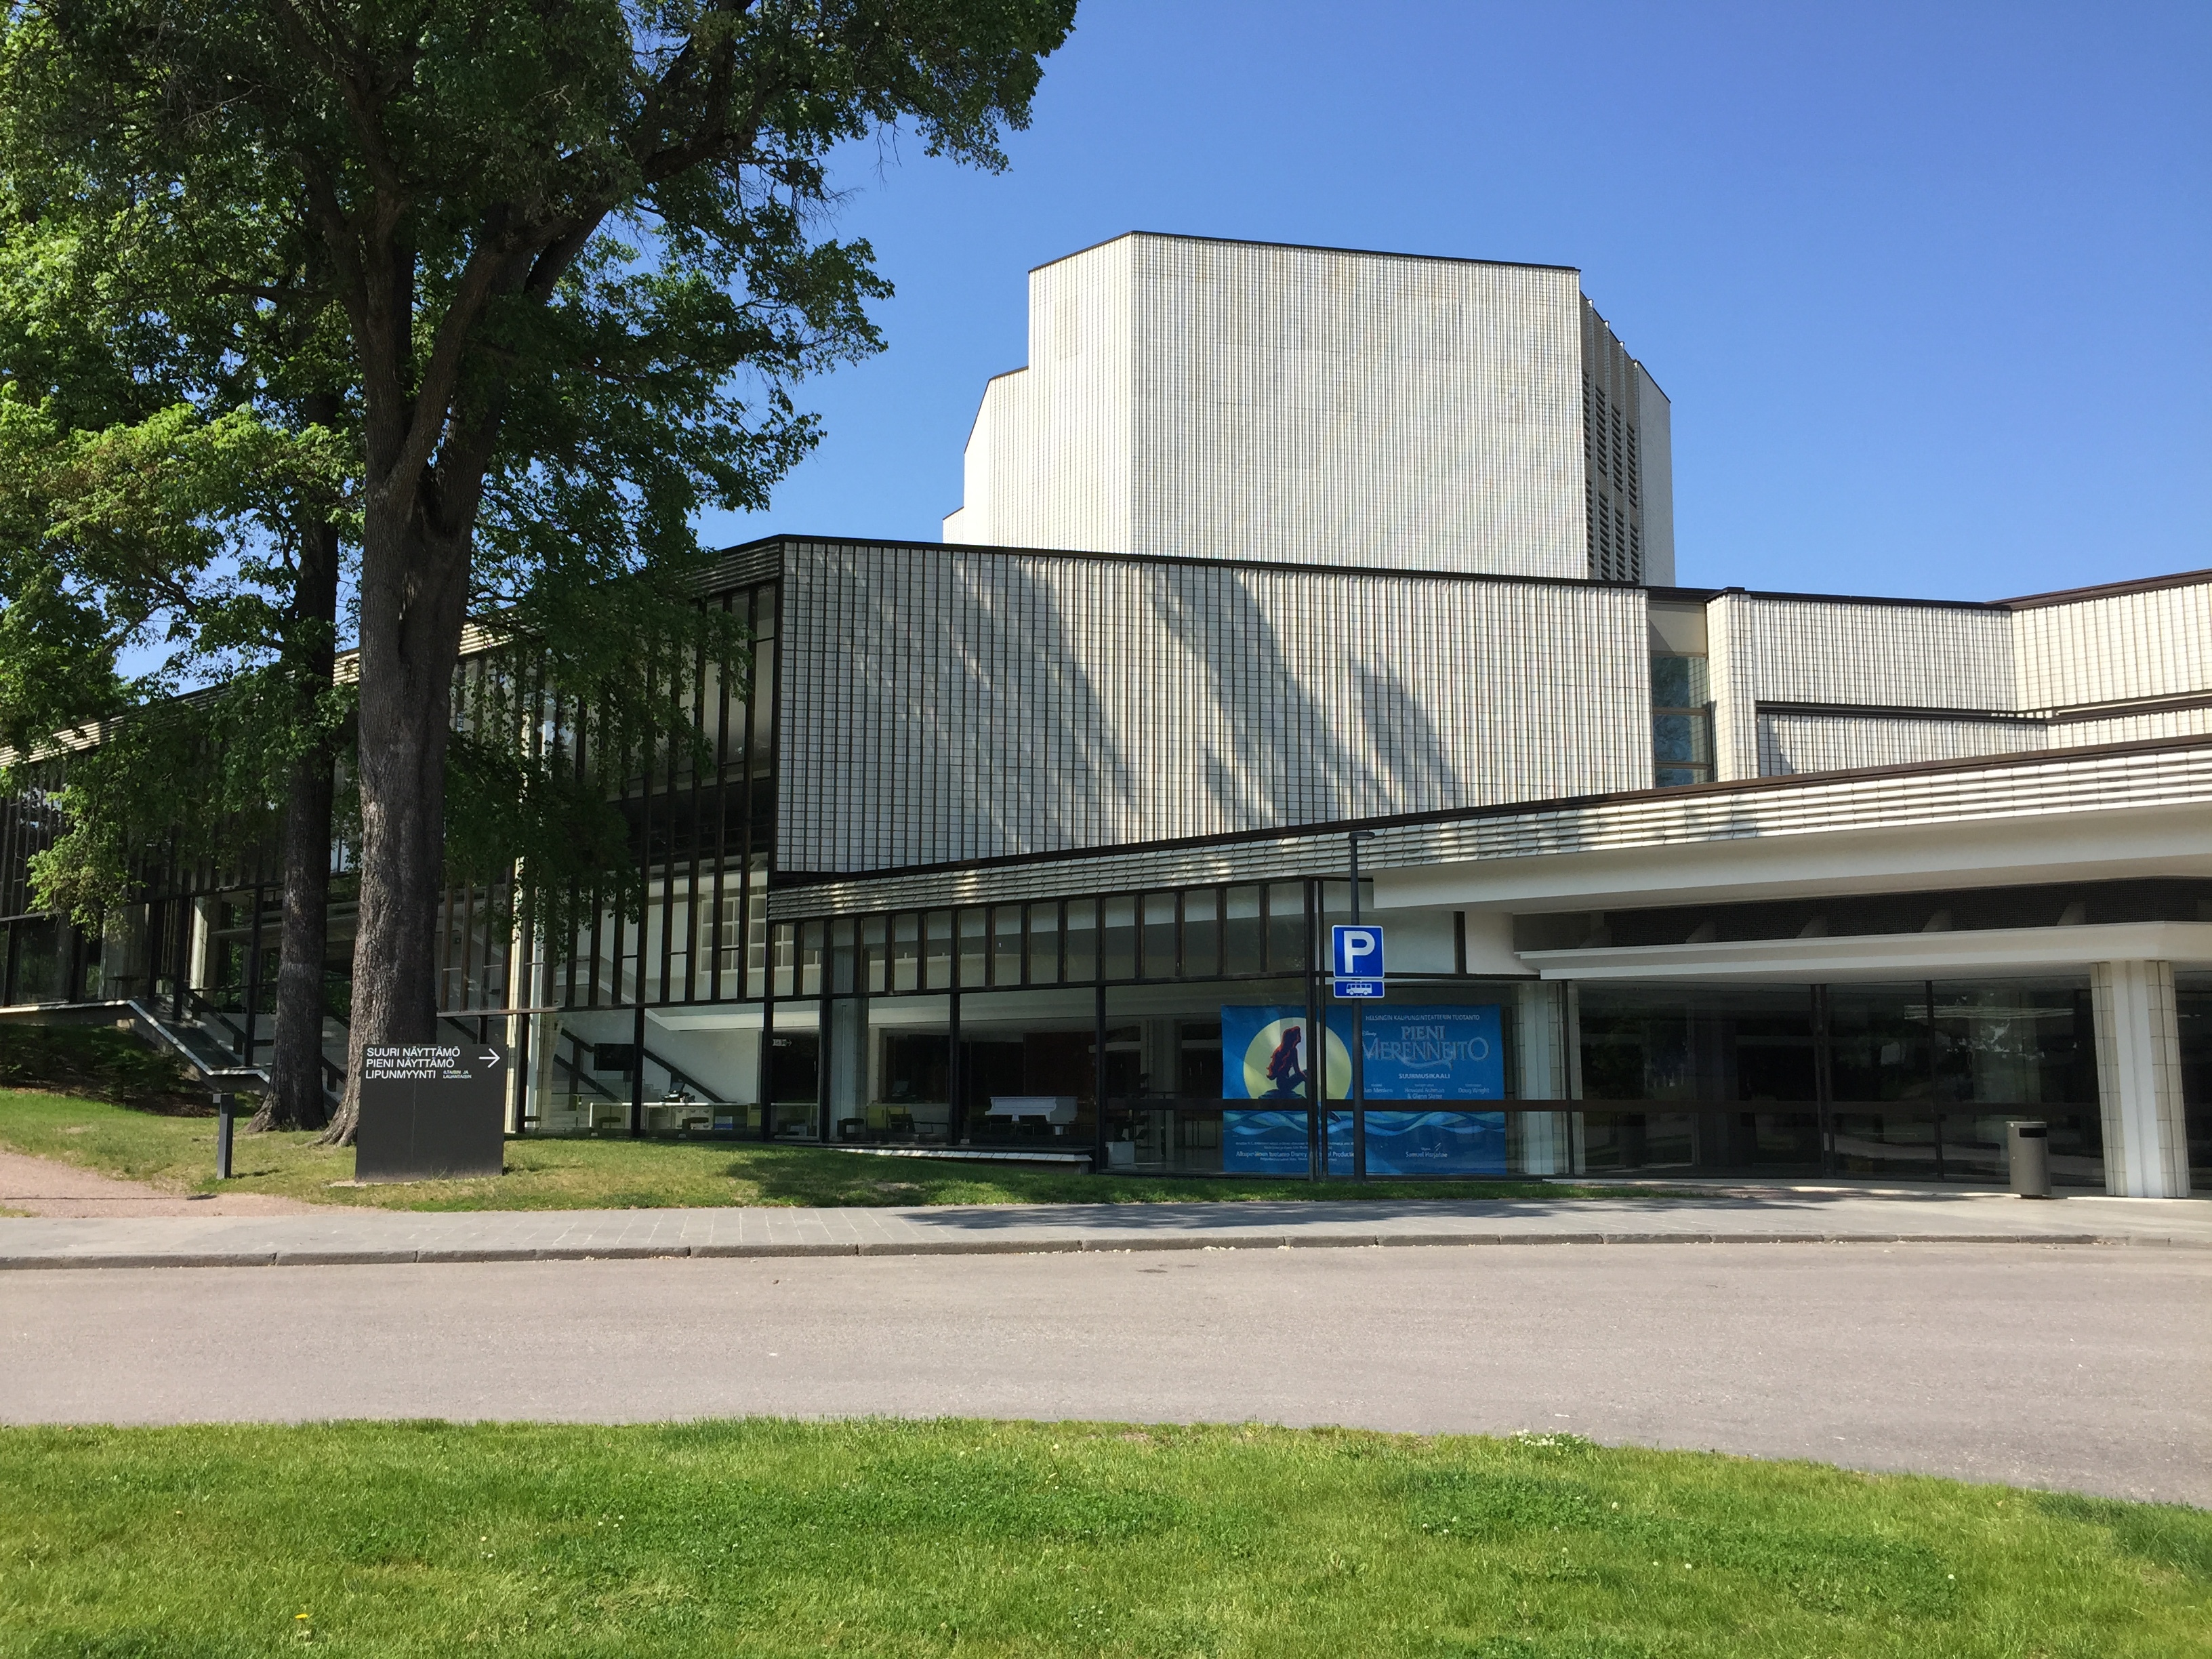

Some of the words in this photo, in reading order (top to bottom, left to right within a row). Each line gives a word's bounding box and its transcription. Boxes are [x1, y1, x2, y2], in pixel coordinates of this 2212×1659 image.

[1344, 930, 1375, 973] P
[1401, 1025, 1446, 1040] PIENI
[367, 1048, 400, 1057] SUURI
[403, 1046, 460, 1057] NÄYTTÄMÖ
[366, 1059, 396, 1067] PIENI
[396, 1057, 454, 1067] NÄYTTÄMÖ
[365, 1070, 436, 1079] LIPUNMYYNTI
